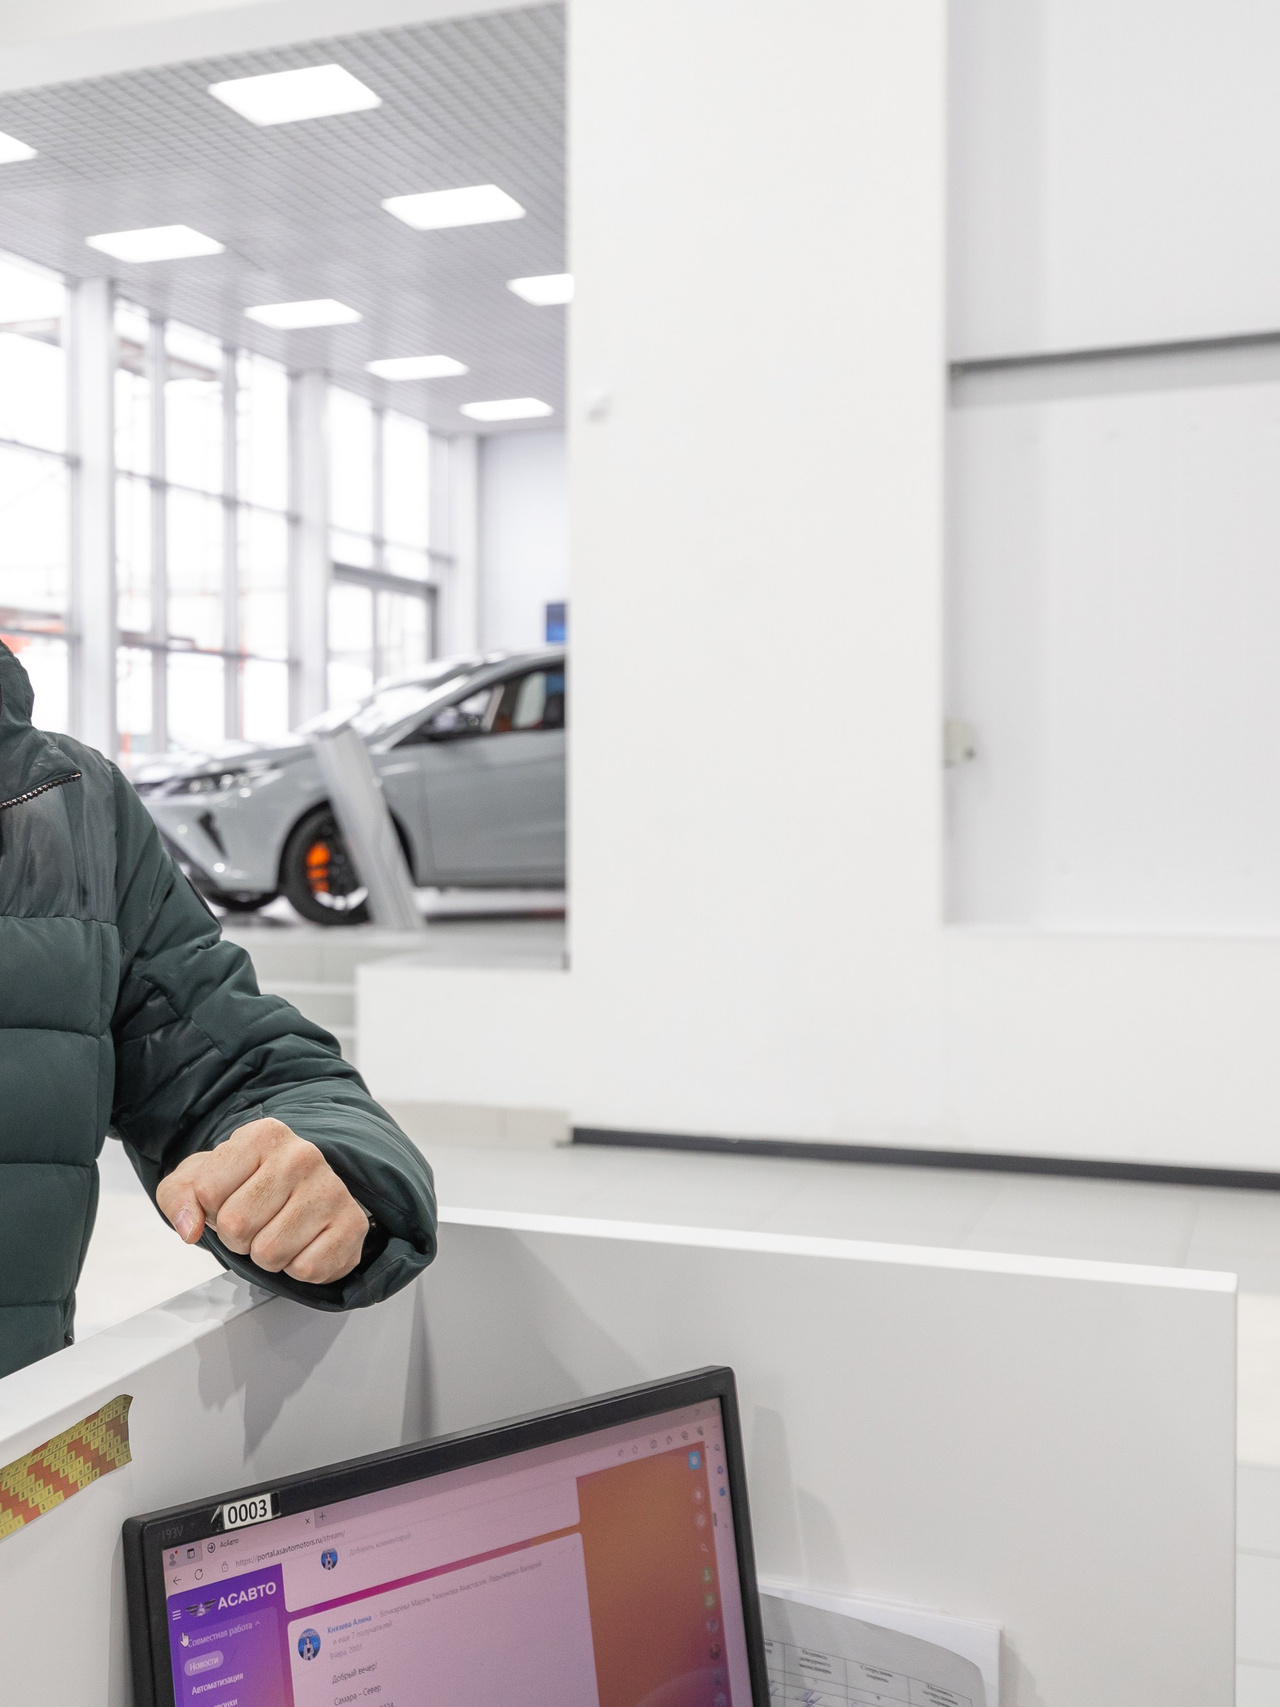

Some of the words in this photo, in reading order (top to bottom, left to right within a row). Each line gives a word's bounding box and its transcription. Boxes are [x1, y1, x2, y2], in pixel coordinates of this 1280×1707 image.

[228, 1499, 268, 1525] 0003
[235, 1529, 346, 1567] https://portal.asavtomotors.ru/stream/
[217, 1581, 277, 1611] АСАВТО
[229, 1622, 253, 1637] работа
[353, 1615, 372, 1627] Алина
[189, 1656, 219, 1672] Новости
[332, 1668, 357, 1684] Добрый
[357, 1661, 378, 1676] вечер!
[191, 1671, 244, 1696] Автоматизация
[334, 1691, 357, 1706] Самара
[362, 1684, 382, 1698] Север
